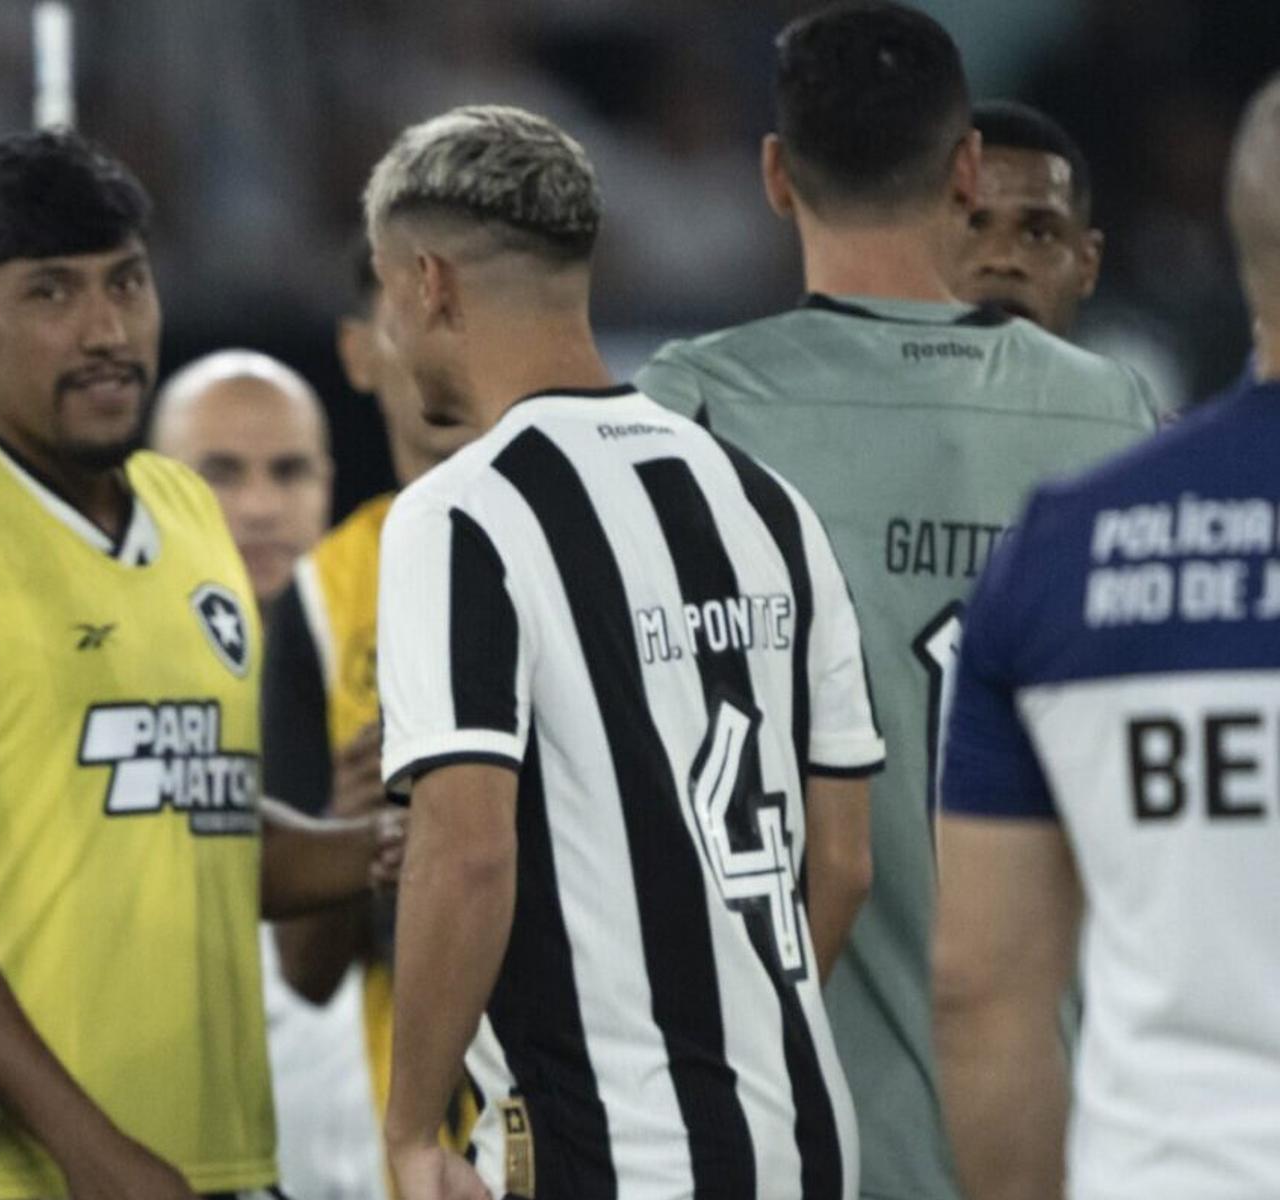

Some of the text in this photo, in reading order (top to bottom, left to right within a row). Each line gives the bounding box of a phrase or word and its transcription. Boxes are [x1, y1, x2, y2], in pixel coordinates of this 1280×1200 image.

[1091, 490, 1274, 564] POLÍCIA
[638, 593, 790, 664] M. PONTE
[1085, 561, 1175, 629] RIO
[1178, 559, 1247, 621] DE
[80, 703, 219, 764] PARI
[1127, 712, 1280, 822] BE
[691, 700, 806, 972] 4
